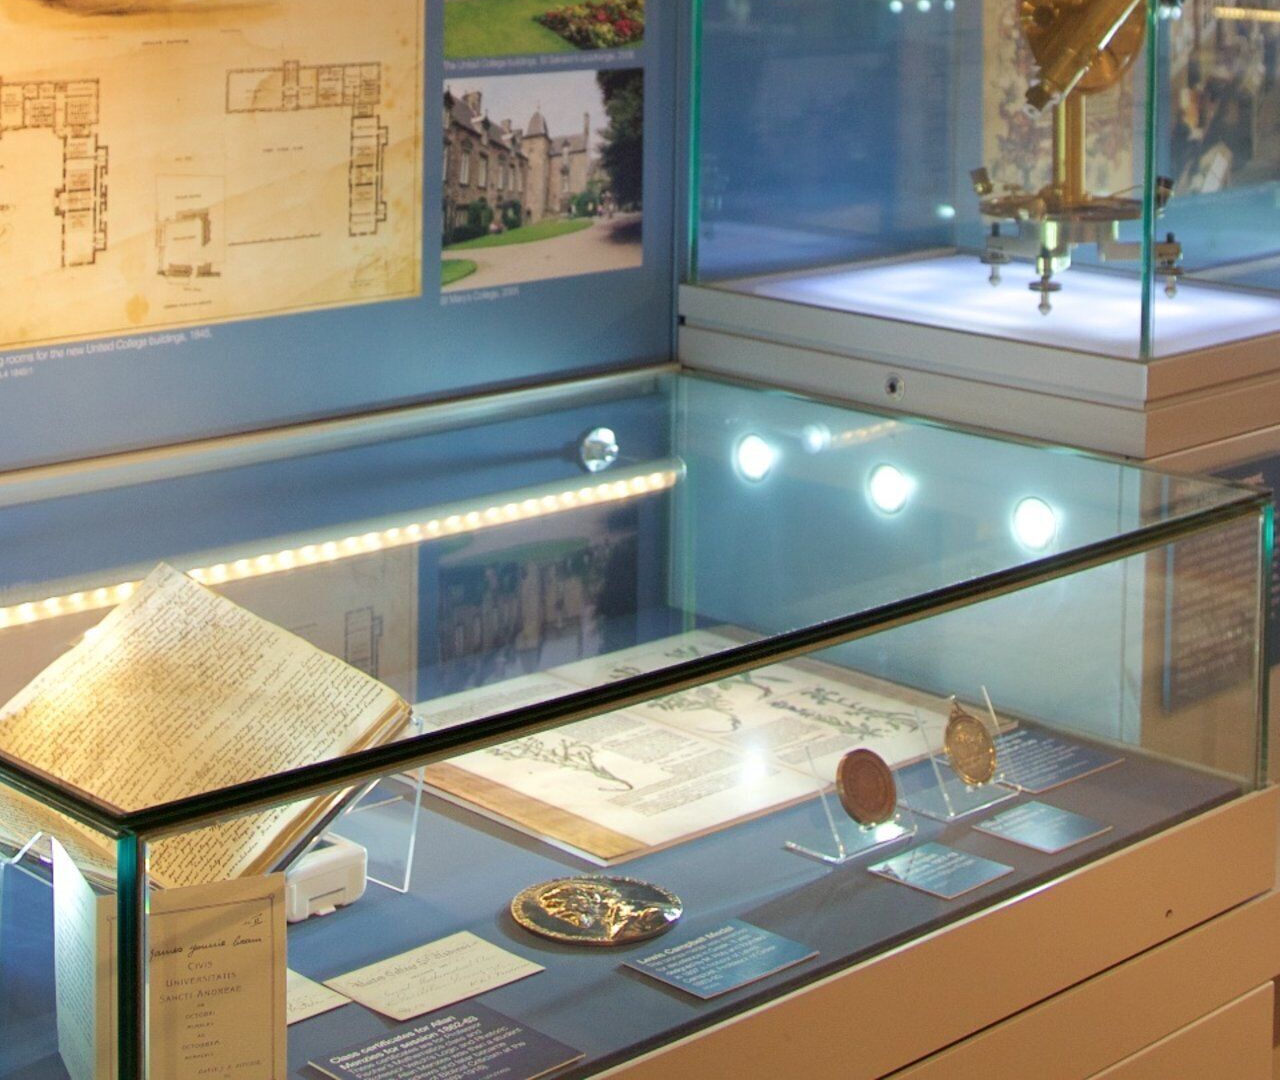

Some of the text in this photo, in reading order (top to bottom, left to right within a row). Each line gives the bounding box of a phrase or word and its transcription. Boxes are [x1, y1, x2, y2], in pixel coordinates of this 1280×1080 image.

[36, 349, 48, 361] for
[50, 347, 64, 359] the
[66, 346, 85, 357] new
[86, 340, 114, 354] United
[116, 337, 146, 351] College
